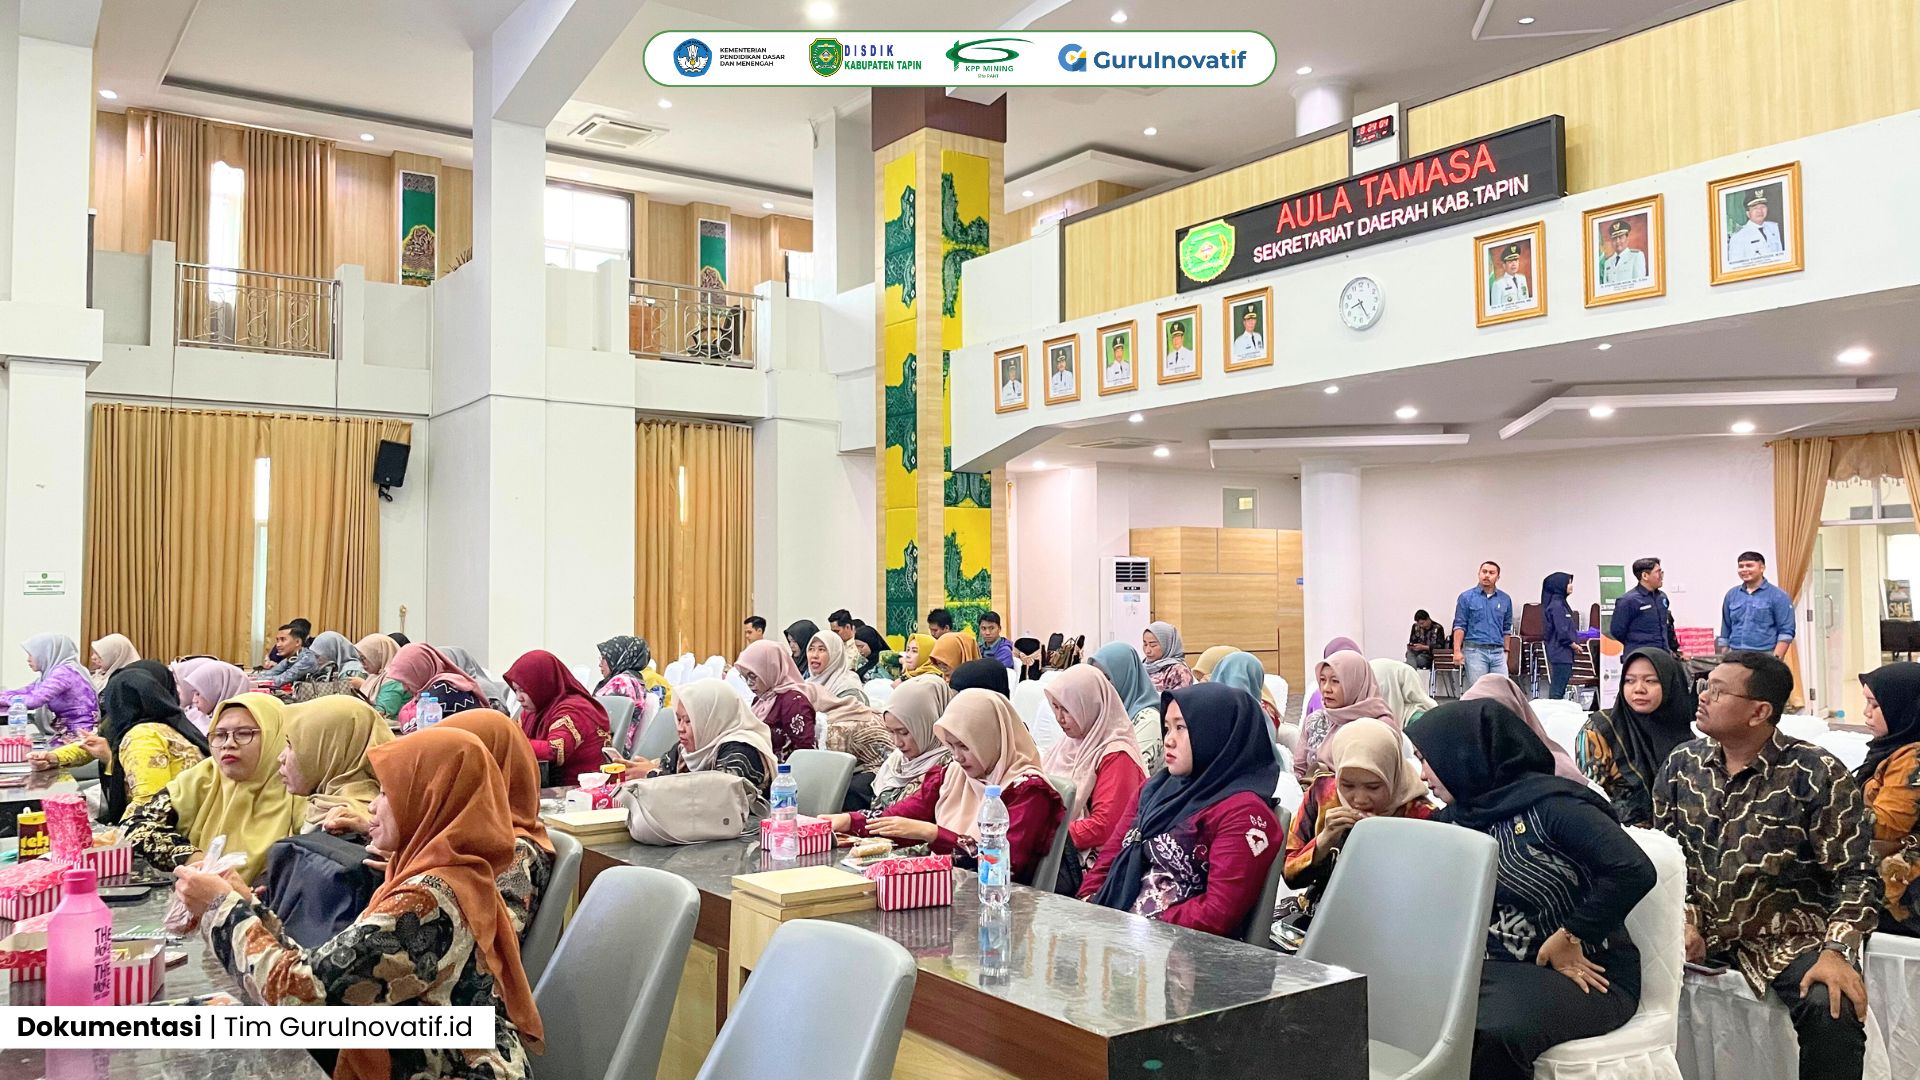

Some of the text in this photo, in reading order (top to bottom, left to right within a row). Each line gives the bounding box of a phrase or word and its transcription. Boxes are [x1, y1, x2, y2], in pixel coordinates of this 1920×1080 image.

[1276, 143, 1497, 234] AULA TAMASA
[1253, 221, 1355, 264] SEKRETARIAT
[1357, 201, 1429, 237] DAERAH
[20, 831, 50, 849] teh
[94, 925, 112, 945] THE
[94, 962, 111, 981] THE
